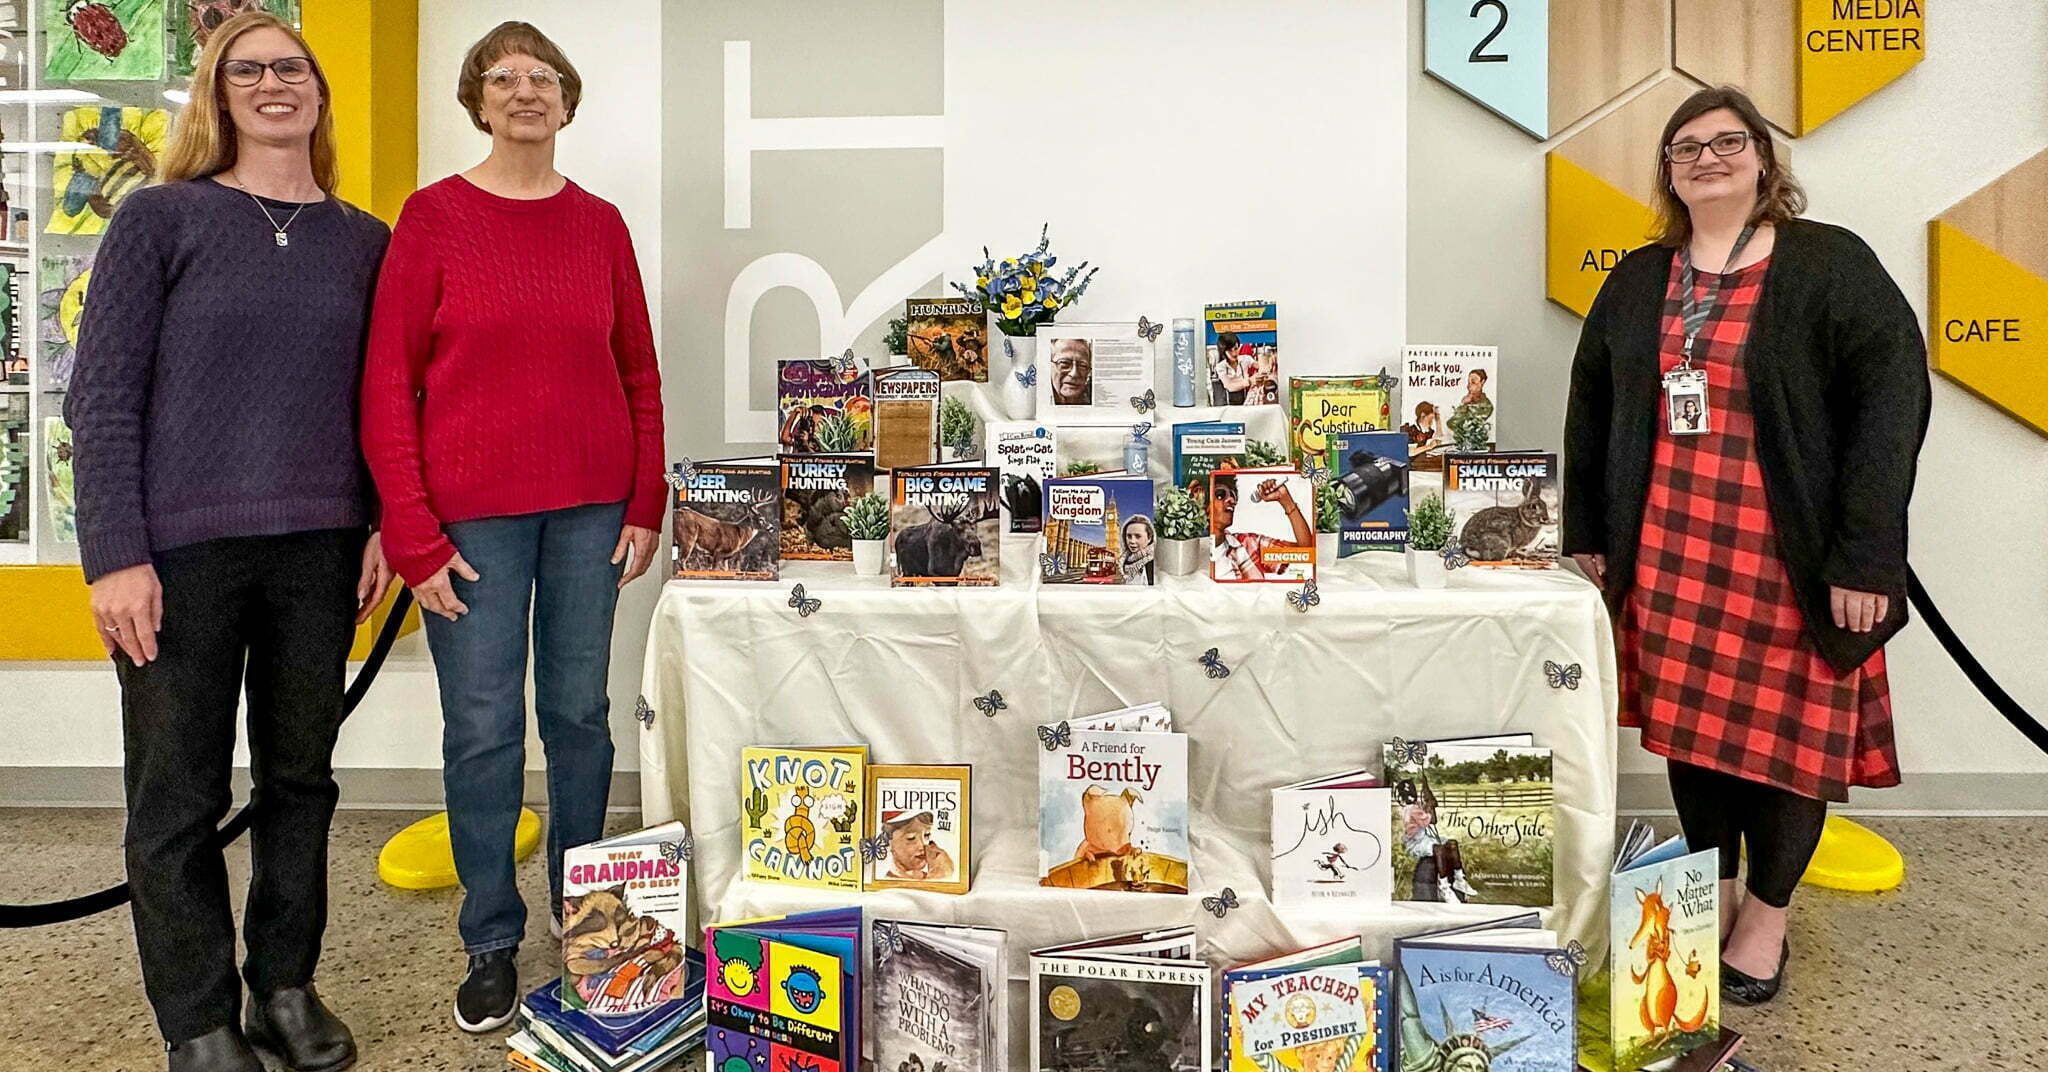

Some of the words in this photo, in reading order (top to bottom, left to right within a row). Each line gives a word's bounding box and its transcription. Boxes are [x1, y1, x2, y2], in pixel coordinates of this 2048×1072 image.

[1832, 0, 1920, 20] MEDIA
[1468, 0, 1509, 63] 2
[1806, 28, 1920, 52] CENTER
[1580, 249, 1629, 272] AD
[911, 303, 983, 316] HUNTING
[1945, 320, 2021, 342] CAFE
[1408, 360, 1441, 373] Thank
[1443, 363, 1462, 374] you,
[875, 381, 939, 394] NEWSPAPERS
[1408, 375, 1427, 387] Mr.
[1429, 375, 1461, 387] Falker
[1321, 399, 1357, 418] Dear
[1237, 426, 1243, 434] 3
[1312, 418, 1376, 436] Substitute
[998, 443, 1025, 455] Splat
[1034, 443, 1053, 453] Cat
[1026, 455, 1040, 464] Flat
[789, 464, 846, 478] TURKEY
[1459, 465, 1502, 477] SMALL
[1506, 465, 1547, 477] GAME
[688, 475, 727, 489] DEER
[788, 477, 848, 490] HUNTING
[905, 477, 934, 492] BIG
[938, 477, 987, 492] GAME
[1459, 478, 1524, 491] HUNTING
[687, 489, 751, 503] HUNTING
[905, 492, 970, 506] HUNTING
[1052, 493, 1090, 504] United
[1052, 505, 1101, 517] Kingdom
[1343, 530, 1408, 542] PHOTOGRAPHY
[1264, 552, 1310, 562] SINGING
[1081, 741, 1090, 752] A
[1092, 741, 1127, 754] Friend
[1129, 743, 1146, 754] for
[748, 755, 852, 793] KNOT
[1066, 754, 1162, 791] Bently
[881, 789, 957, 811] PUPPIES
[937, 810, 949, 820] FOR
[937, 821, 952, 831] SALE
[1441, 807, 1468, 828] The
[1468, 809, 1514, 840] Other
[1501, 810, 1546, 849] Side
[608, 851, 643, 860] WHAT
[749, 838, 856, 880] CANNOT
[569, 859, 681, 884] GRANDMAS
[1685, 868, 1703, 887] No
[630, 881, 646, 889] DO
[650, 879, 681, 888] BEST
[1677, 883, 1714, 905] Matter
[1682, 898, 1713, 918] What
[1040, 962, 1069, 974] THE
[1078, 965, 1128, 978] POLAR
[1137, 969, 1205, 983] EXPRESS
[898, 970, 932, 996] WHAT
[933, 986, 950, 1006] DO
[898, 983, 927, 1009] YOU
[930, 1000, 950, 1022] DO
[1241, 993, 1268, 1024] MY
[1271, 975, 1359, 1006] TEACHER
[1419, 963, 1437, 987] A
[1440, 968, 1451, 983] is
[1454, 966, 1475, 983] for
[1477, 963, 1567, 1035] America
[711, 999, 728, 1015] It's
[731, 1005, 755, 1024] Okay
[758, 1012, 770, 1025] to
[772, 1016, 785, 1030] Be
[788, 1020, 834, 1044] Different
[898, 1000, 936, 1034] WITH
[938, 1023, 949, 1041] A
[898, 1016, 956, 1057] PROBLEM?
[1254, 1039, 1274, 1052] for
[1280, 1021, 1358, 1047] PRESIDENT
